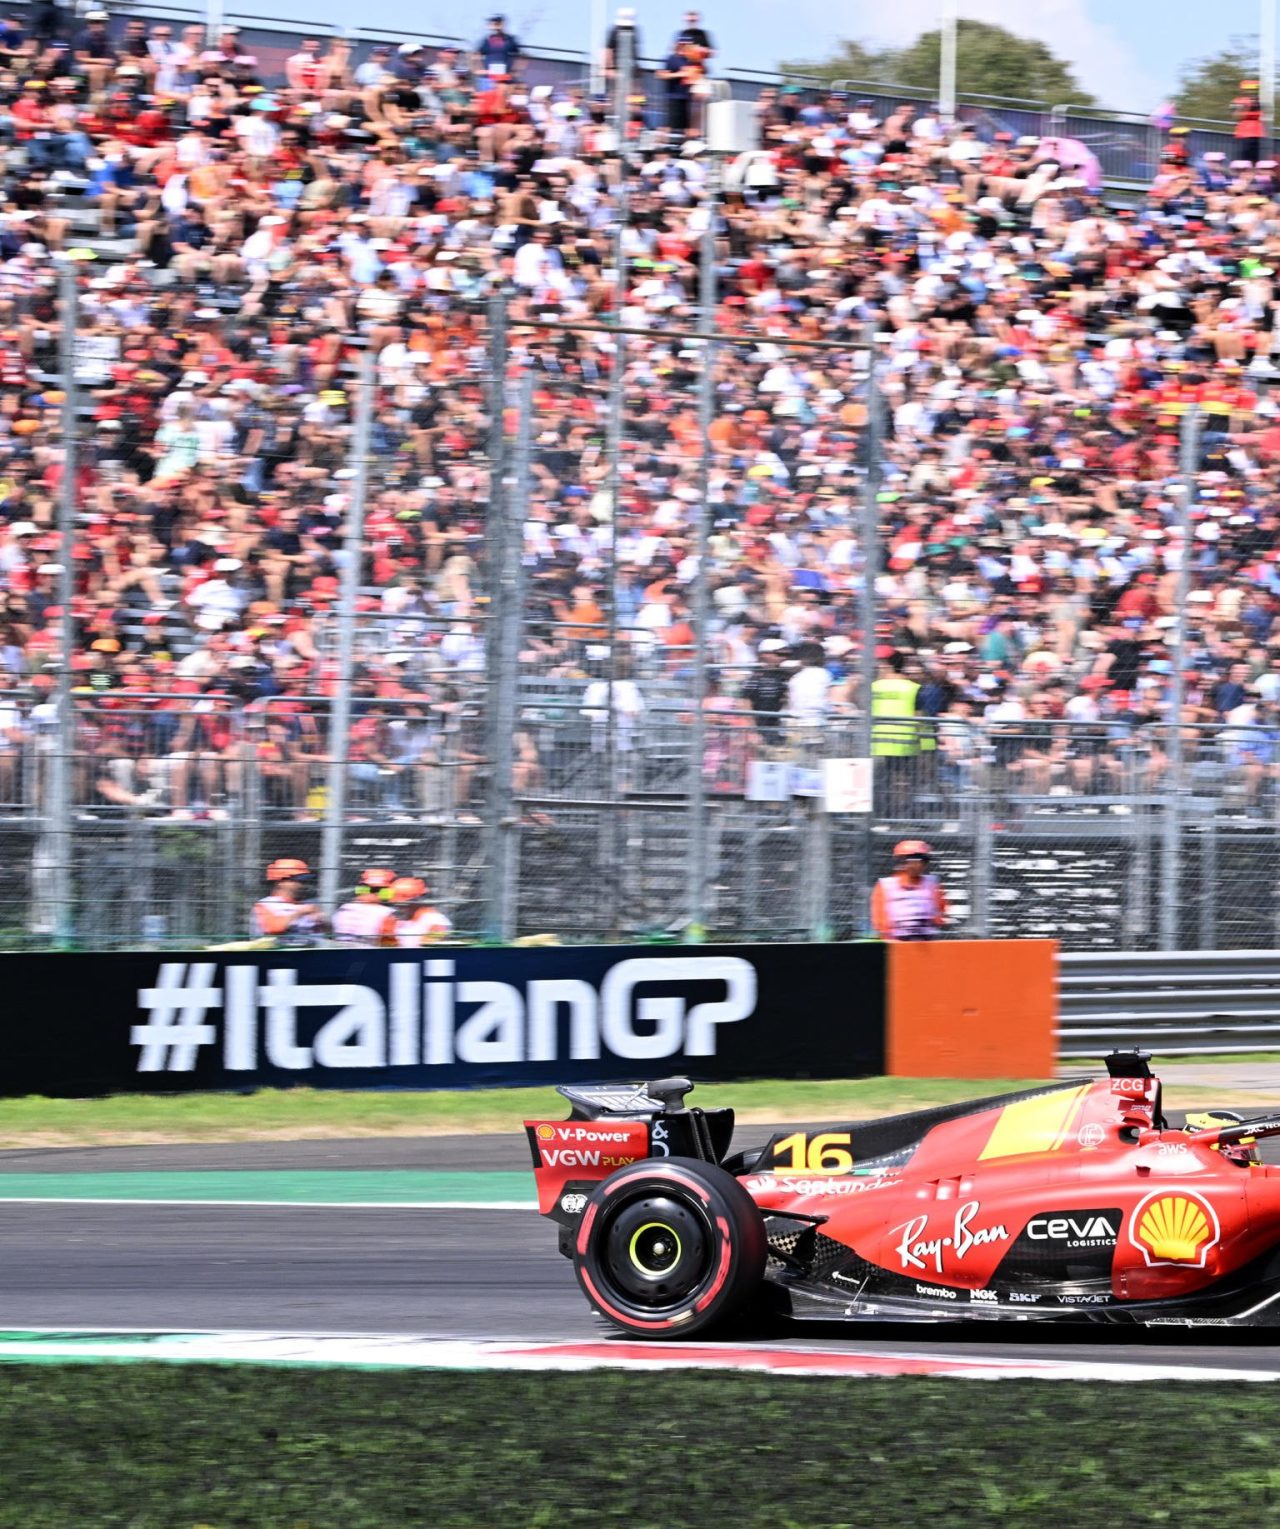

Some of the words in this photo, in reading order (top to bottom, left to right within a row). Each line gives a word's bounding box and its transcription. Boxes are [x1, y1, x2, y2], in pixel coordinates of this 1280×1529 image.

[131, 956, 757, 1072] #ItalianGP
[557, 1127, 631, 1143] V-Power
[773, 1132, 854, 1176] 16
[1158, 1143, 1188, 1155] aws
[541, 1149, 601, 1167] VGW
[602, 1156, 636, 1167] PLAY
[780, 1176, 904, 1196] Santander
[1067, 1238, 1118, 1248] LOGISTICS
[916, 1284, 957, 1299] brembo
[970, 1289, 998, 1301] NGK
[1009, 1292, 1042, 1302] SKF
